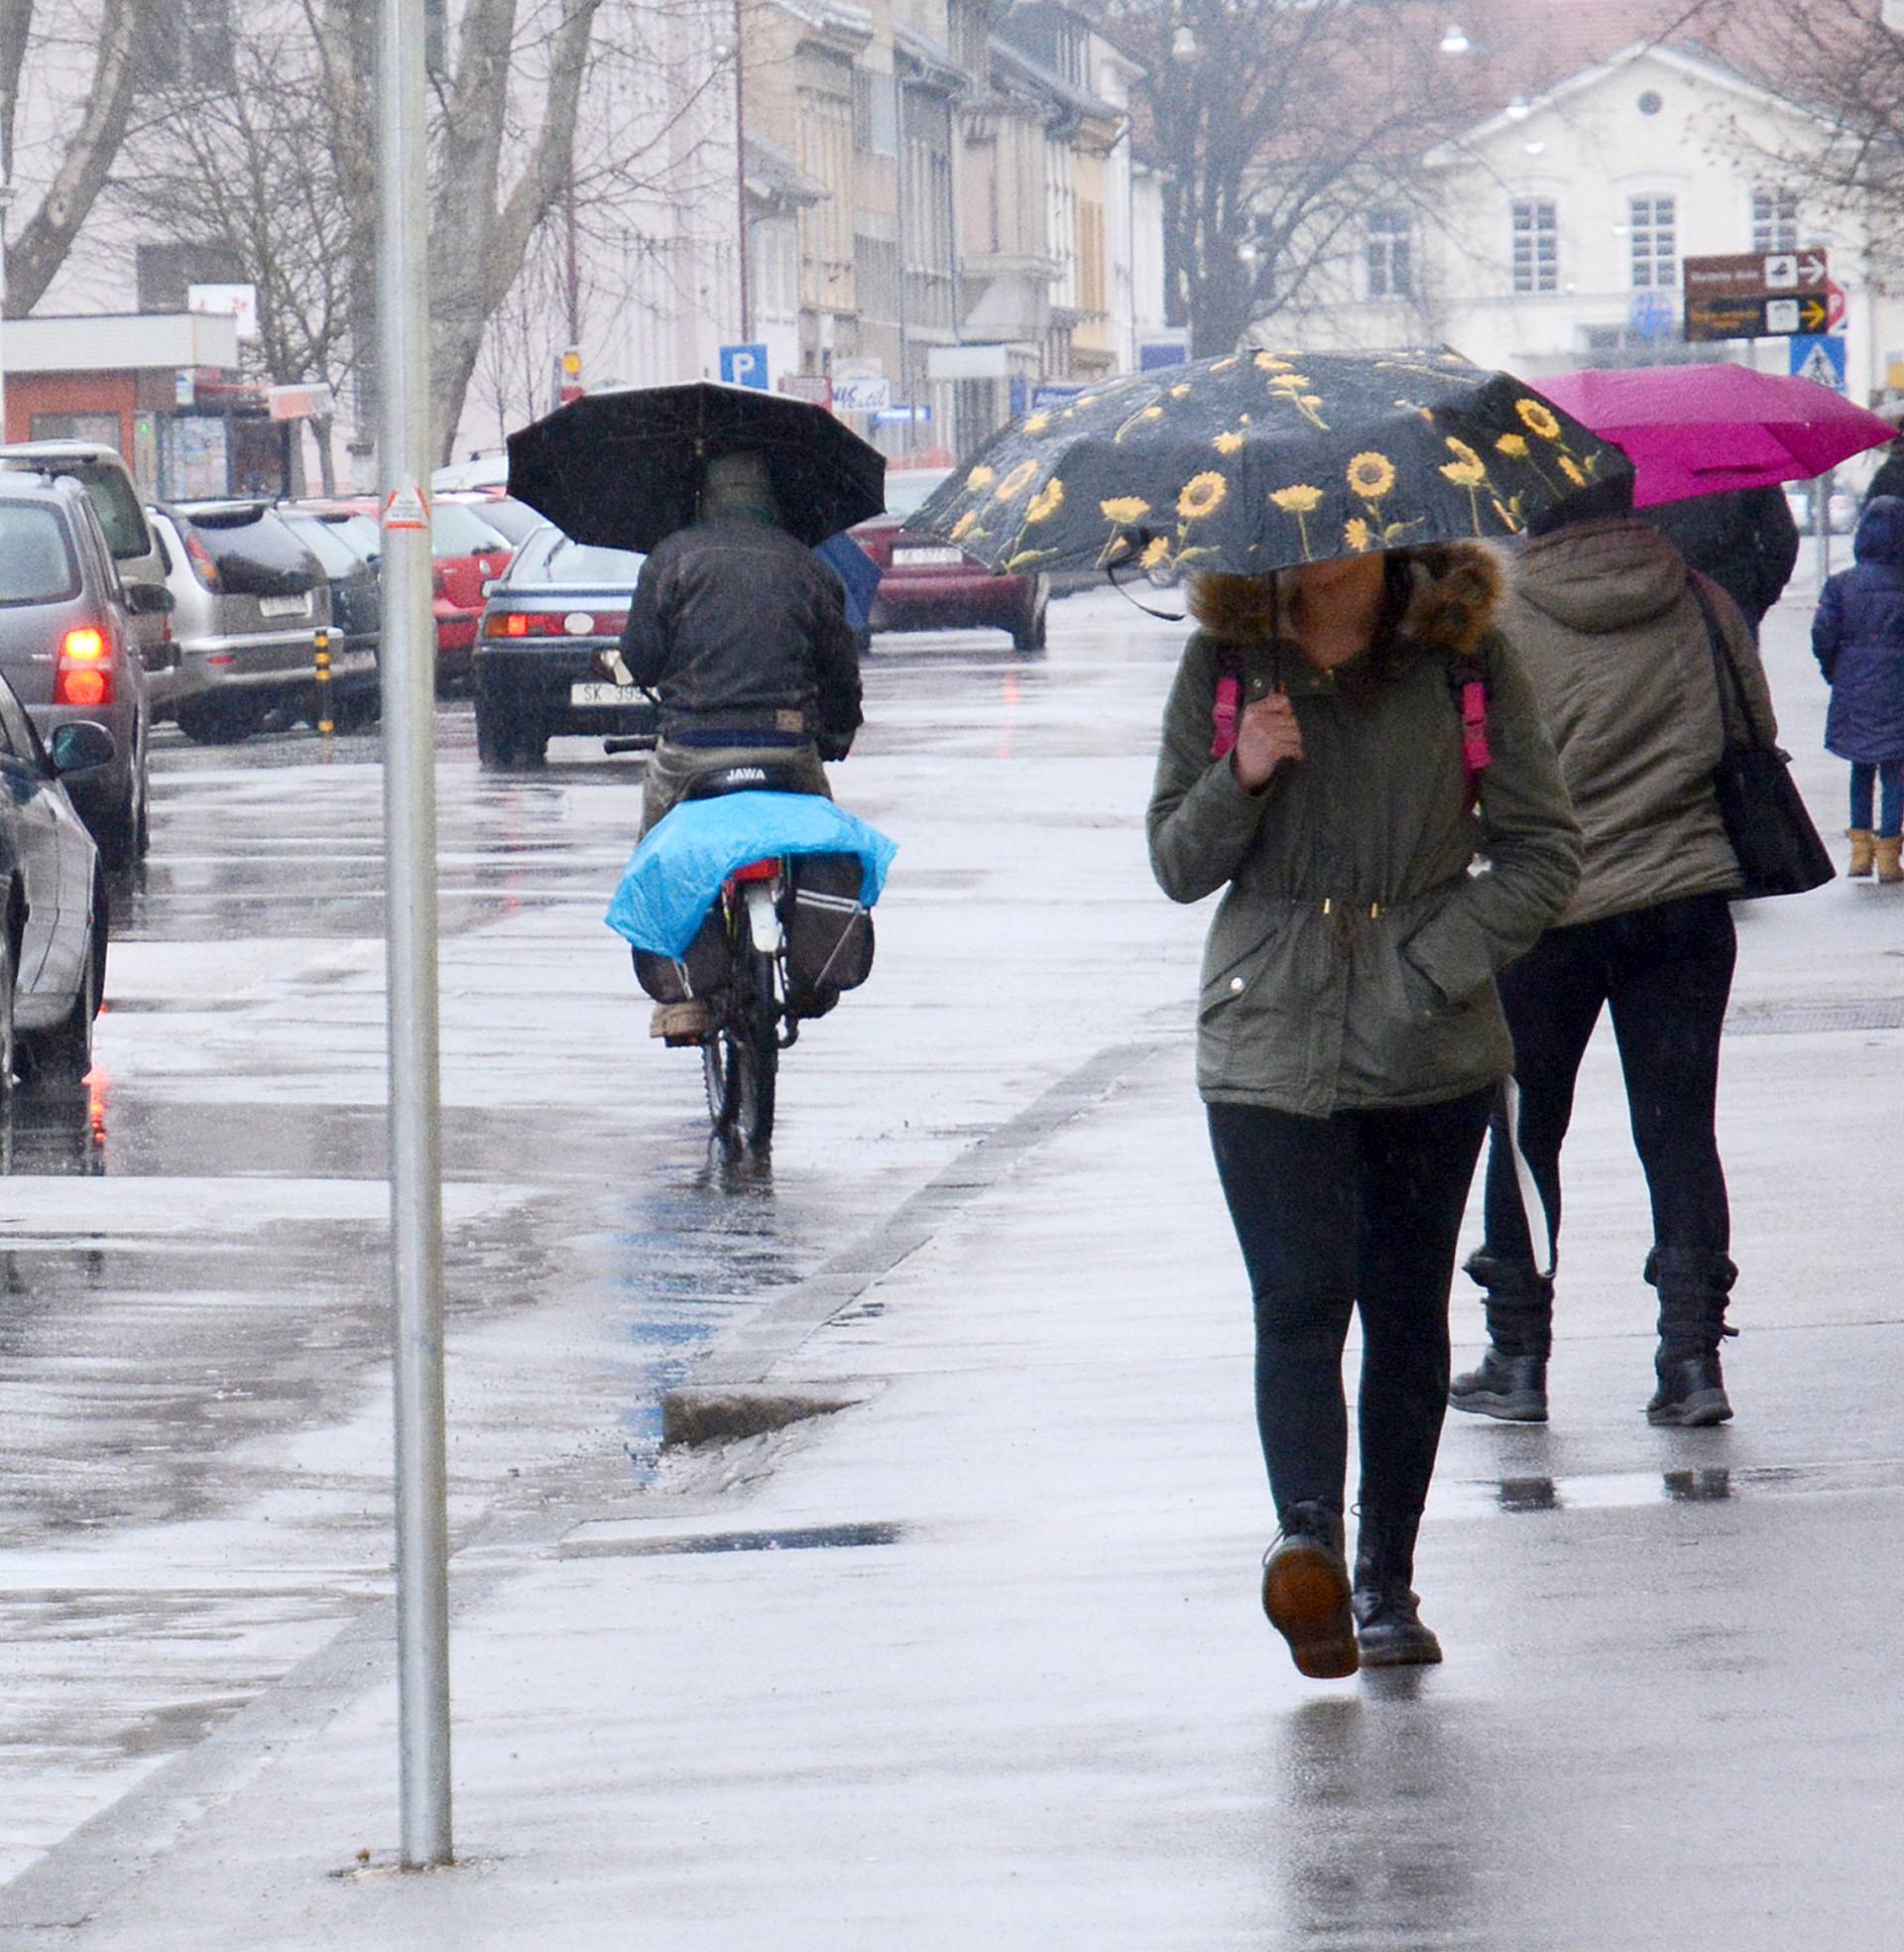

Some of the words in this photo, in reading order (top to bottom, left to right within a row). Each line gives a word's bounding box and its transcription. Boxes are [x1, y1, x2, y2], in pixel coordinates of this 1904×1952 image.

[732, 352, 755, 384] P
[583, 684, 602, 701] SK
[726, 768, 766, 782] JAWA
